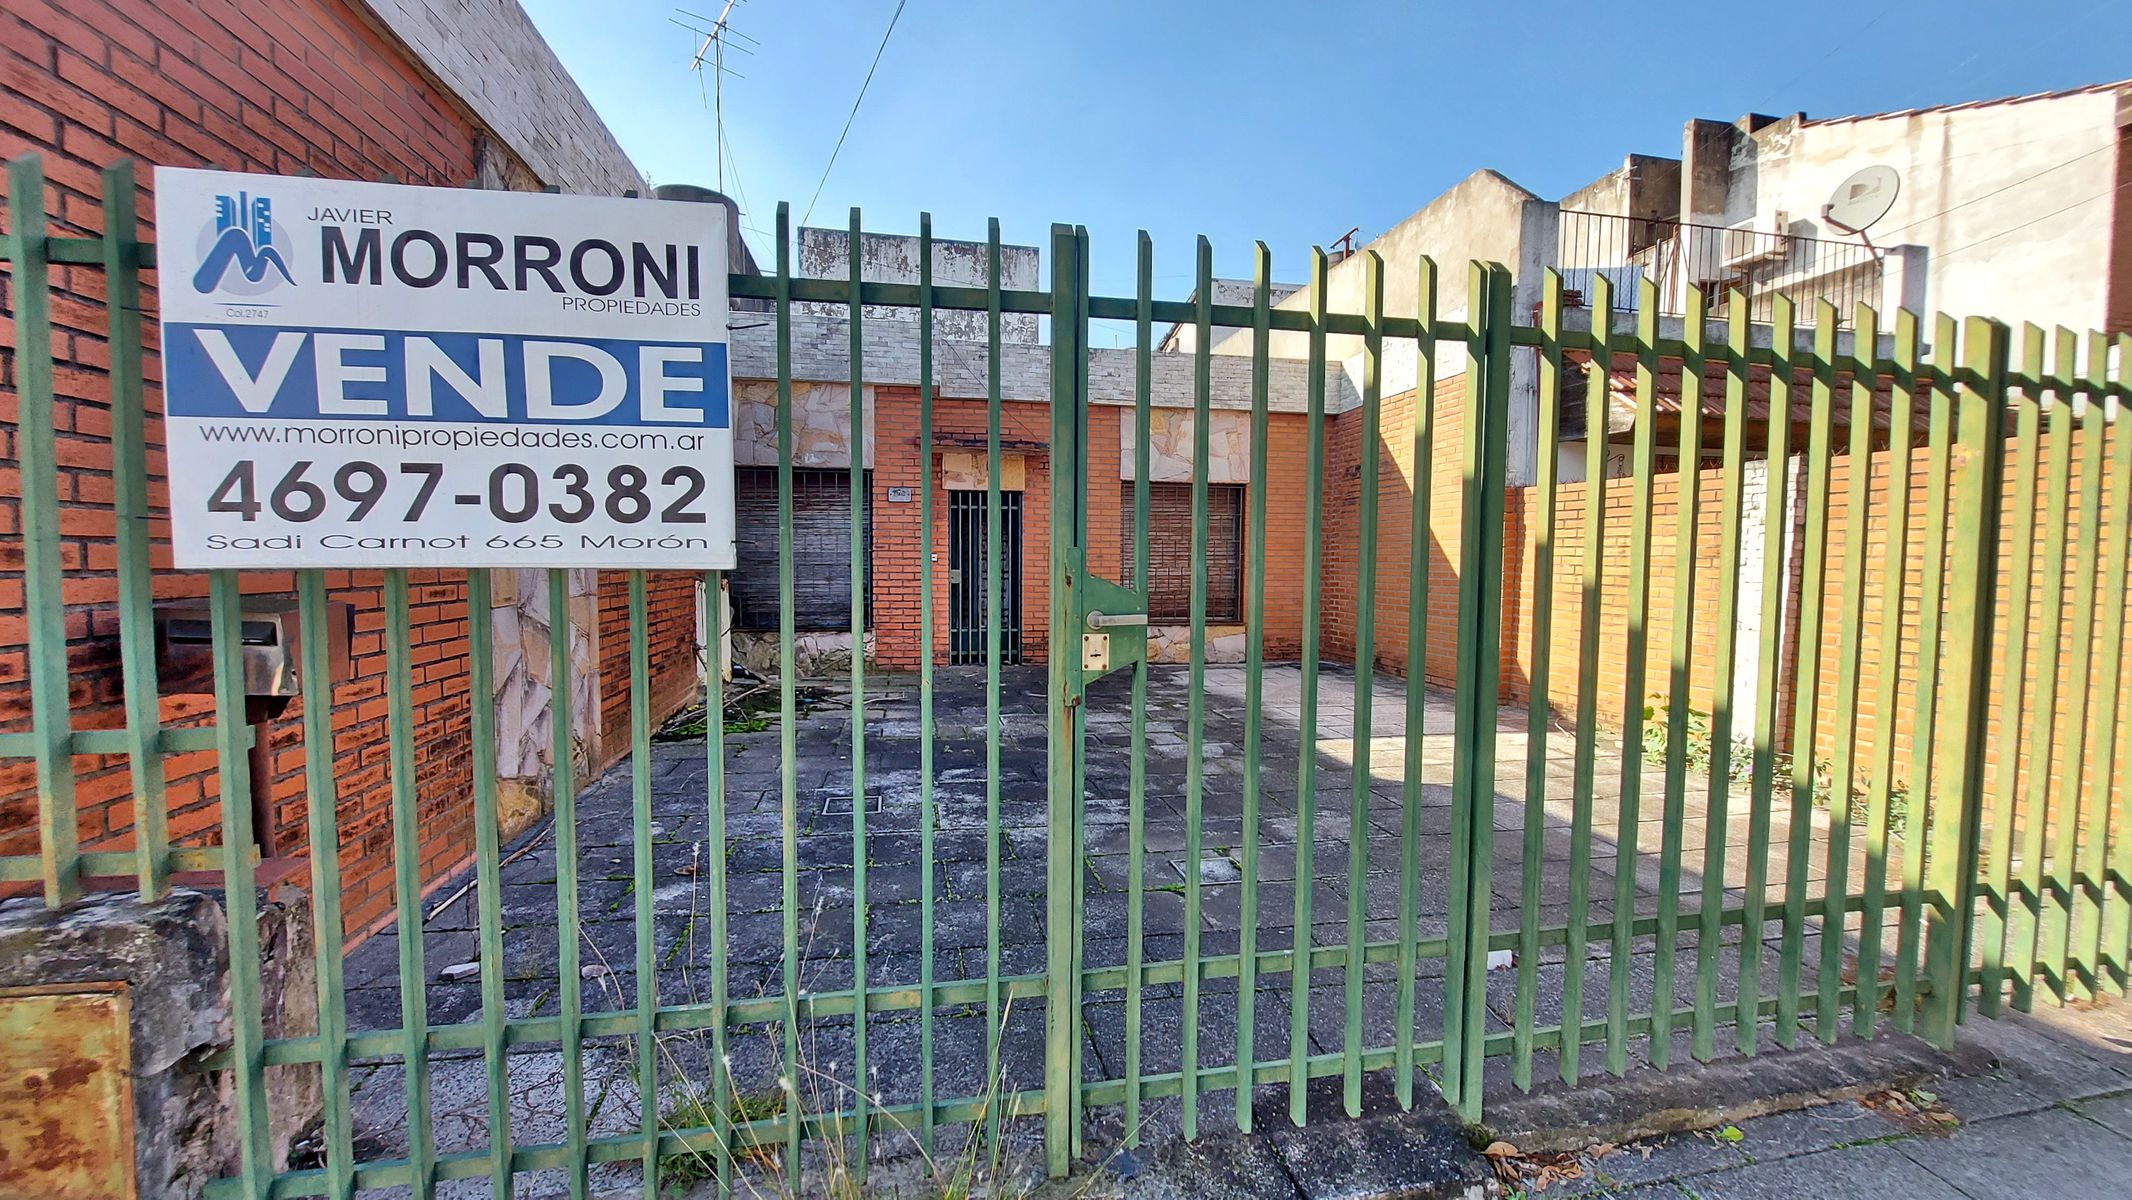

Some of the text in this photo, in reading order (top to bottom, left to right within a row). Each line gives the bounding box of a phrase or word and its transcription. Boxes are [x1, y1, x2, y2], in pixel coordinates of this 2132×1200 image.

[307, 207, 393, 225] JAVIER
[321, 226, 701, 300] MORRONI
[226, 308, 269, 319] Col.2747
[562, 296, 701, 317] PROPIEDADES
[193, 328, 704, 422] VENDE
[199, 425, 705, 450] www.morronipropiedades.com.ar
[207, 460, 706, 524] 4697-0382
[207, 533, 708, 549] Sadi Carnot 665 Morón
